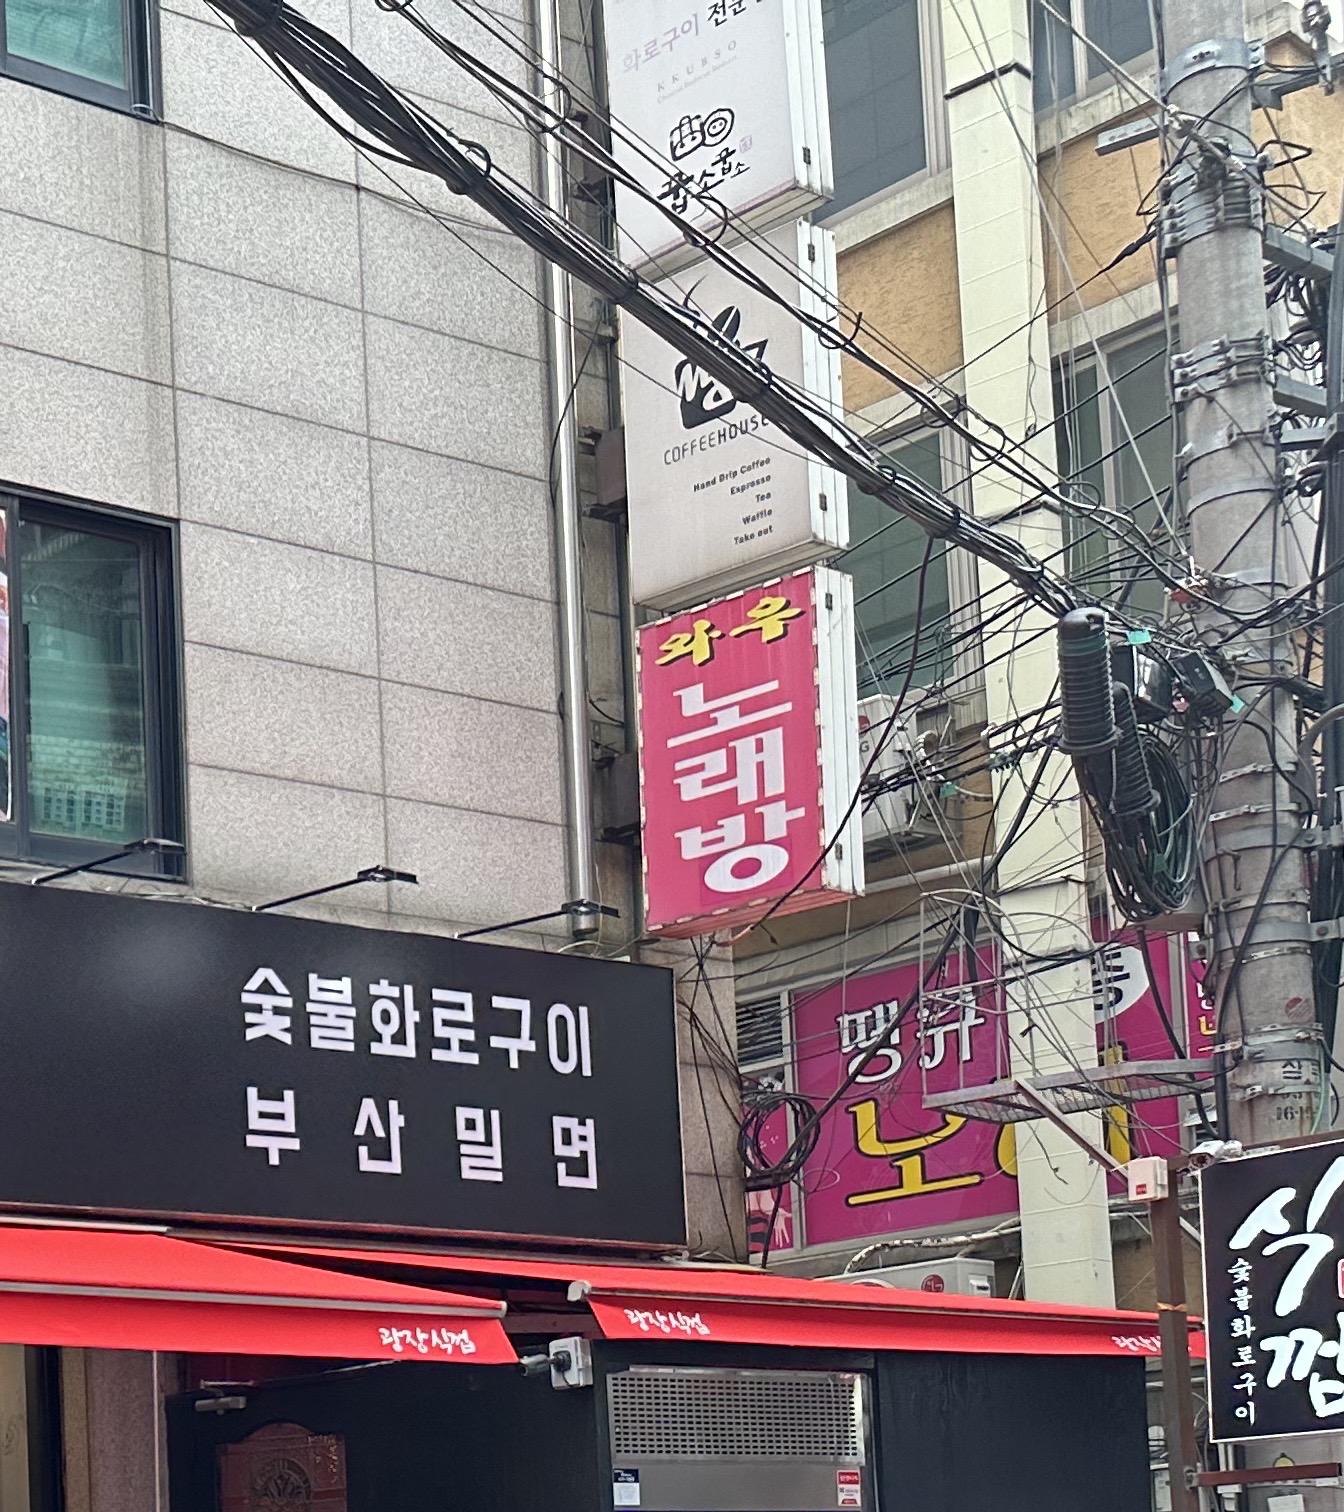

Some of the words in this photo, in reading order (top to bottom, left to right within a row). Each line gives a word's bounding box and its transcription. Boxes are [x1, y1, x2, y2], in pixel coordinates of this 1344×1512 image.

[693, 476, 717, 492] Hand
[740, 456, 771, 474] Coffee
[755, 492, 772, 503] Tea
[733, 532, 755, 545] Take
[757, 524, 773, 537] out
[742, 508, 773, 525] Waffle
[654, 596, 803, 668] 와우
[667, 678, 805, 894] 노래방
[240, 966, 593, 1078] 숯불화로구이
[1227, 1257, 1257, 1427] 숯불화로구이
